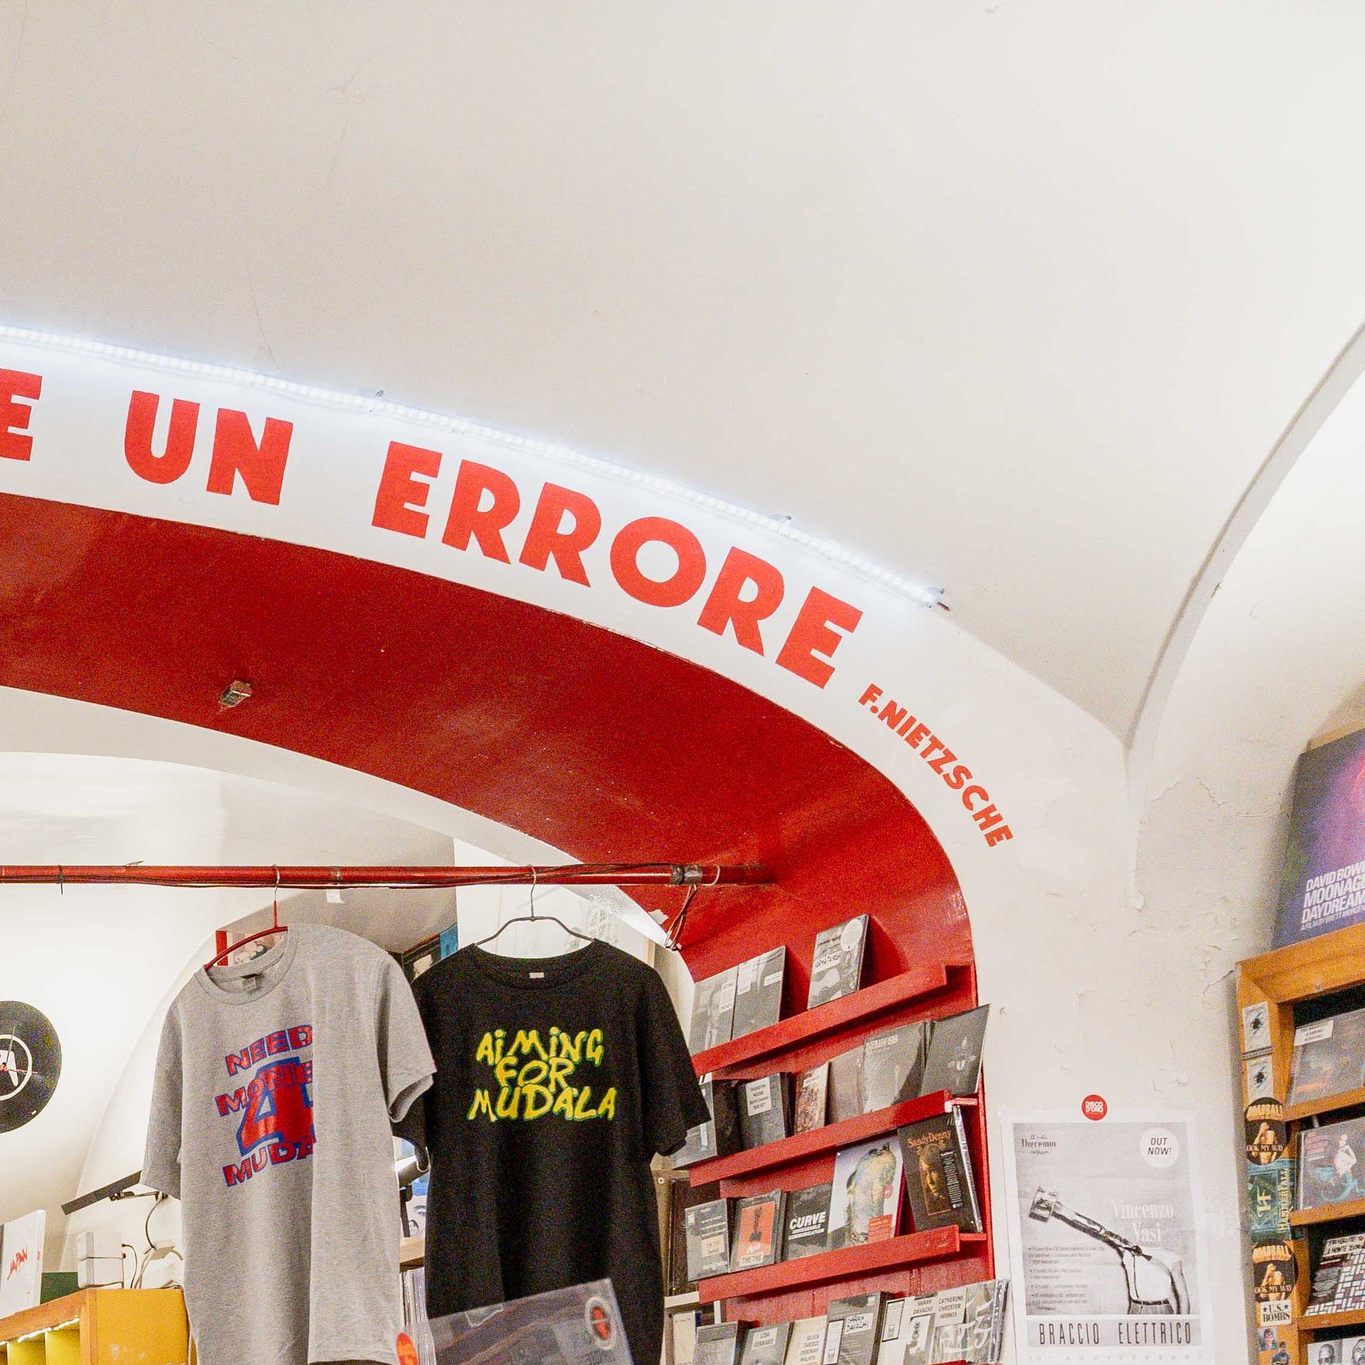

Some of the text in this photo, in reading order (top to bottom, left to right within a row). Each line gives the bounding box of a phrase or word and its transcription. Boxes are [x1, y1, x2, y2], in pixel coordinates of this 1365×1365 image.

[123, 390, 294, 505] UN
[370, 440, 864, 690] ERRORE
[225, 1024, 314, 1077] NEED
[495, 1056, 577, 1094] FOR
[214, 1064, 314, 1118] MONE
[236, 1056, 314, 1157] 4
[469, 1083, 616, 1122] MUDALA
[1147, 1146, 1172, 1156] NOW!
[1150, 1137, 1168, 1146] OUT
[789, 1212, 826, 1230] CURVE
[1112, 1199, 1175, 1220] Vincenzo
[1131, 1219, 1163, 1243] Vasi
[1039, 1322, 1192, 1345] BRACCIO ELETTRICO
